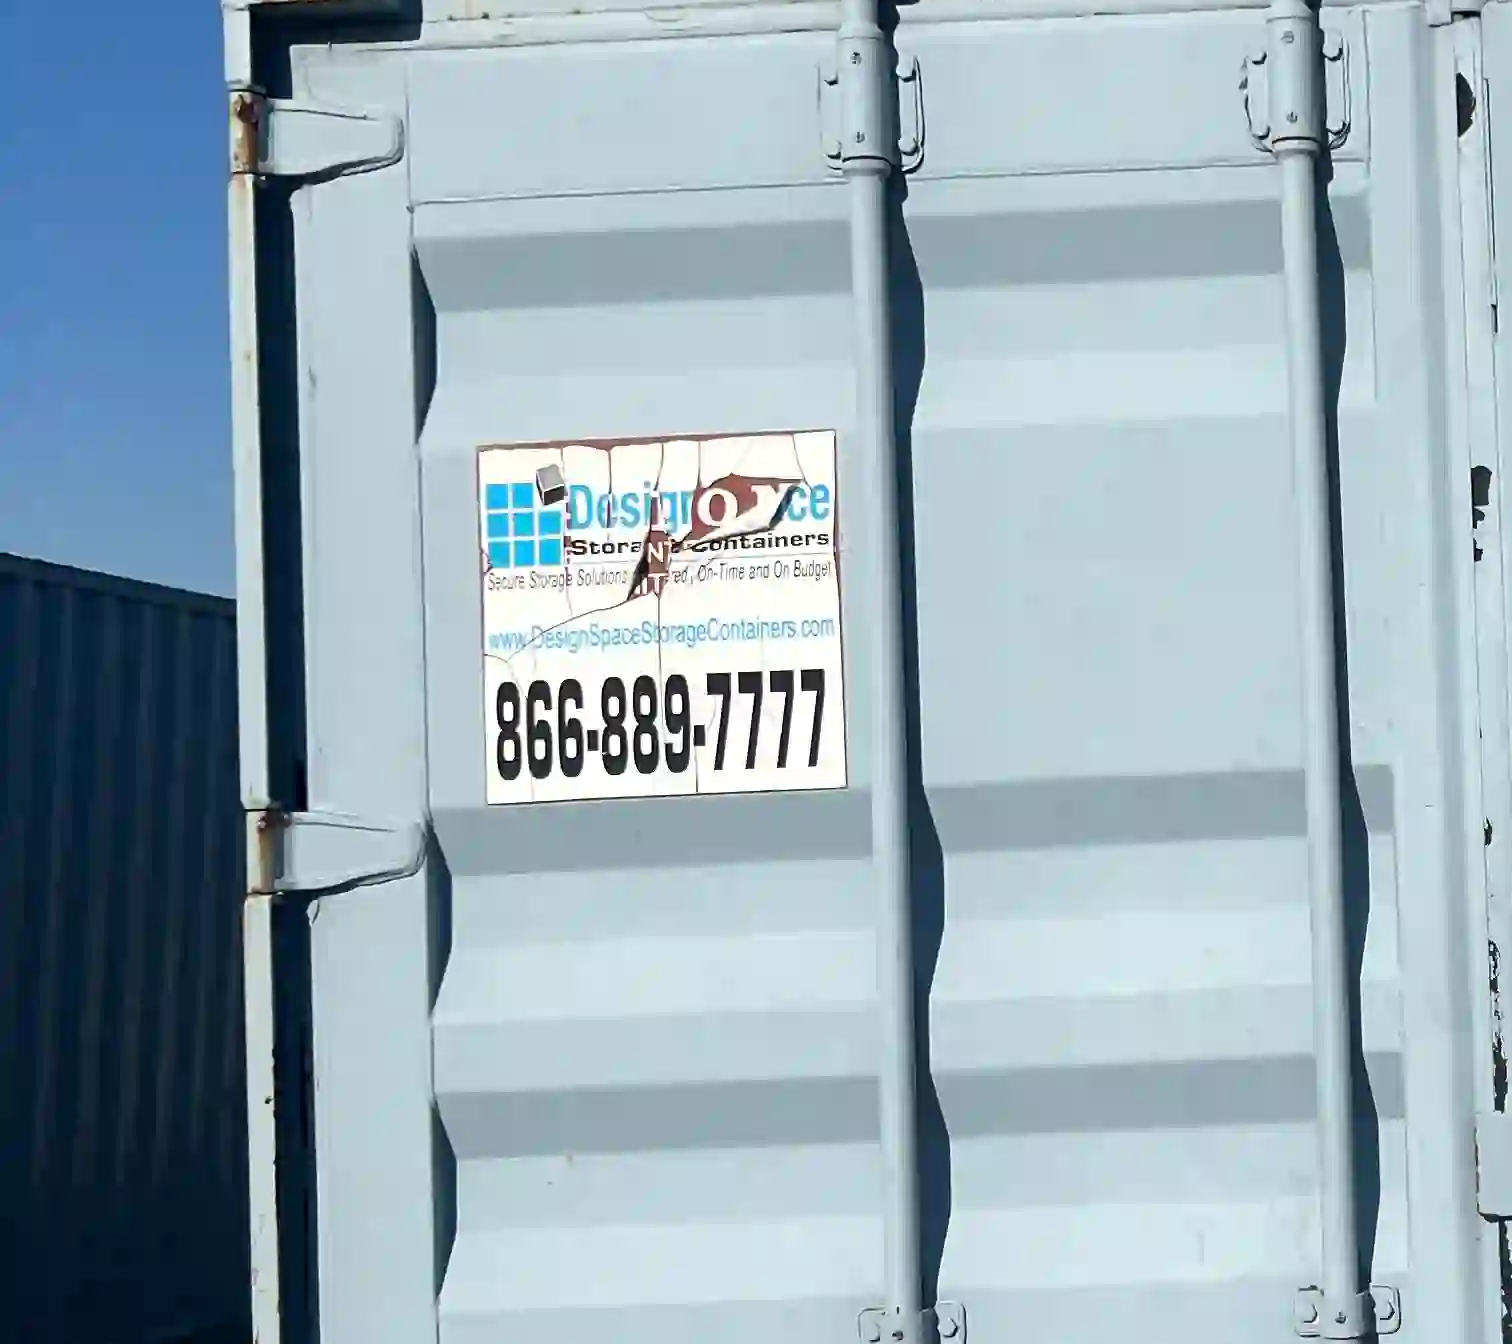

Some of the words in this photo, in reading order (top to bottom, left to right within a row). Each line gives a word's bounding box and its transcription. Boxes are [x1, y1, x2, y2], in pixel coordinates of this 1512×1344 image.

[487, 572, 525, 591] Secure
[529, 570, 573, 593] Storage
[577, 568, 628, 587] Solutions
[698, 562, 745, 582] On-Time
[749, 563, 770, 580] and
[774, 559, 790, 578] On
[496, 668, 825, 780] 866-889-7777
